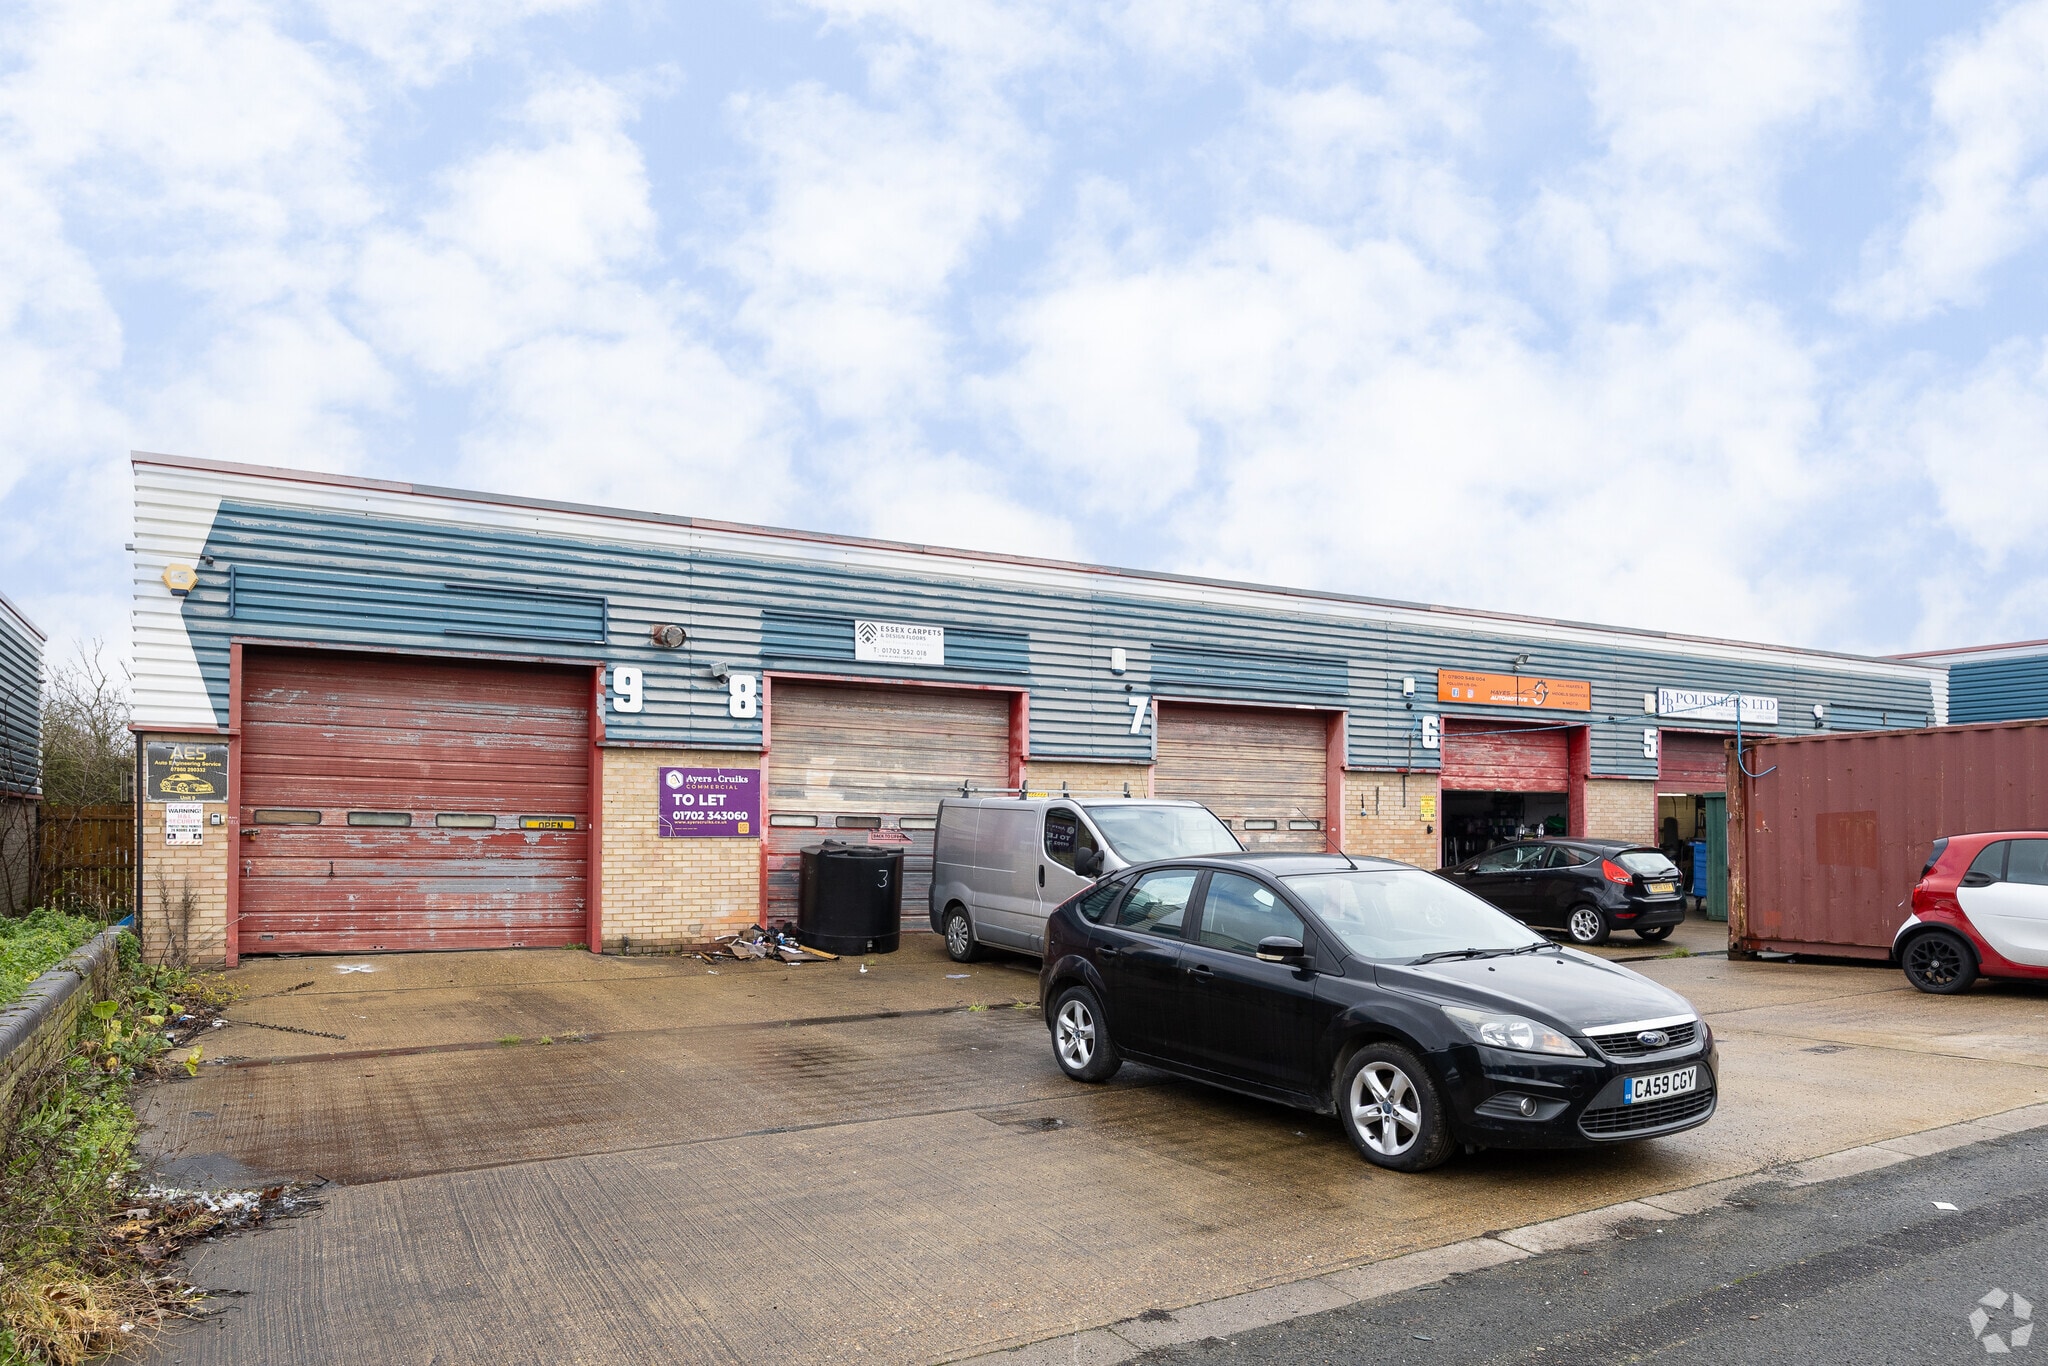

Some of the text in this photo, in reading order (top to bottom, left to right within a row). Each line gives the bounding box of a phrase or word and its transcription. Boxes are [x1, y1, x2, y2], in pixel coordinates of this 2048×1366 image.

[880, 625, 942, 637] ESSEX CARPETS
[882, 647, 900, 655] 01702
[916, 649, 927, 657] 018
[612, 667, 643, 713] 9
[729, 675, 757, 719] 8
[1490, 695, 1529, 703] AUTOMOTIVE
[1750, 699, 1775, 711] LTD
[1129, 696, 1149, 734] 7
[1422, 715, 1438, 749] 6
[1643, 729, 1657, 758] 5
[170, 746, 207, 761] AES
[686, 775, 712, 784] Ayers
[718, 775, 749, 783] Cruiks
[672, 794, 727, 806] TO LET
[672, 811, 748, 821] 01702 343060
[877, 869, 889, 888] 3
[1635, 1069, 1695, 1099] CA59 CGY
